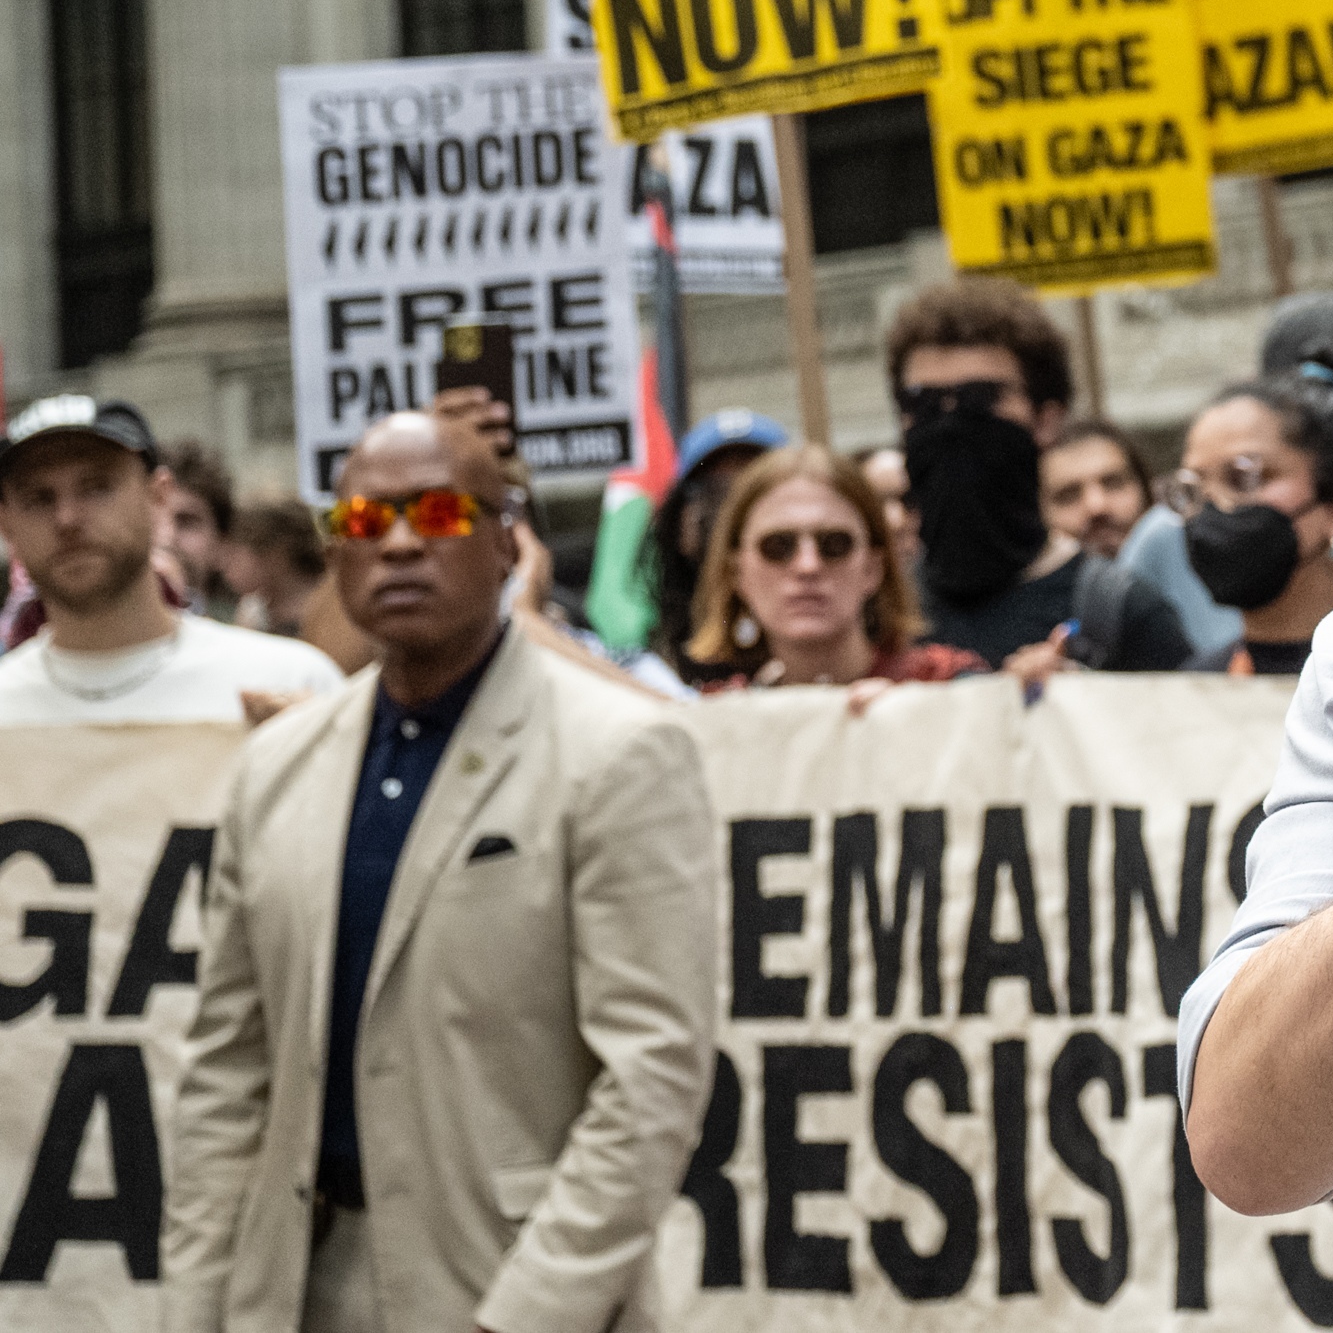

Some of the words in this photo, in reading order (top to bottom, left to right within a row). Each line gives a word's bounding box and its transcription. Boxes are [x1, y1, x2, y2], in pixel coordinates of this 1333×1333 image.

[970, 32, 1154, 107] SIEGE
[316, 127, 598, 206] GENOCIDE
[956, 133, 1027, 189] ON
[1048, 118, 1189, 179] GAZA
[327, 276, 605, 353] FREE
[329, 342, 611, 421] PALINE
[0, 818, 216, 1023] GA
[728, 796, 1266, 1020] EMAIN
